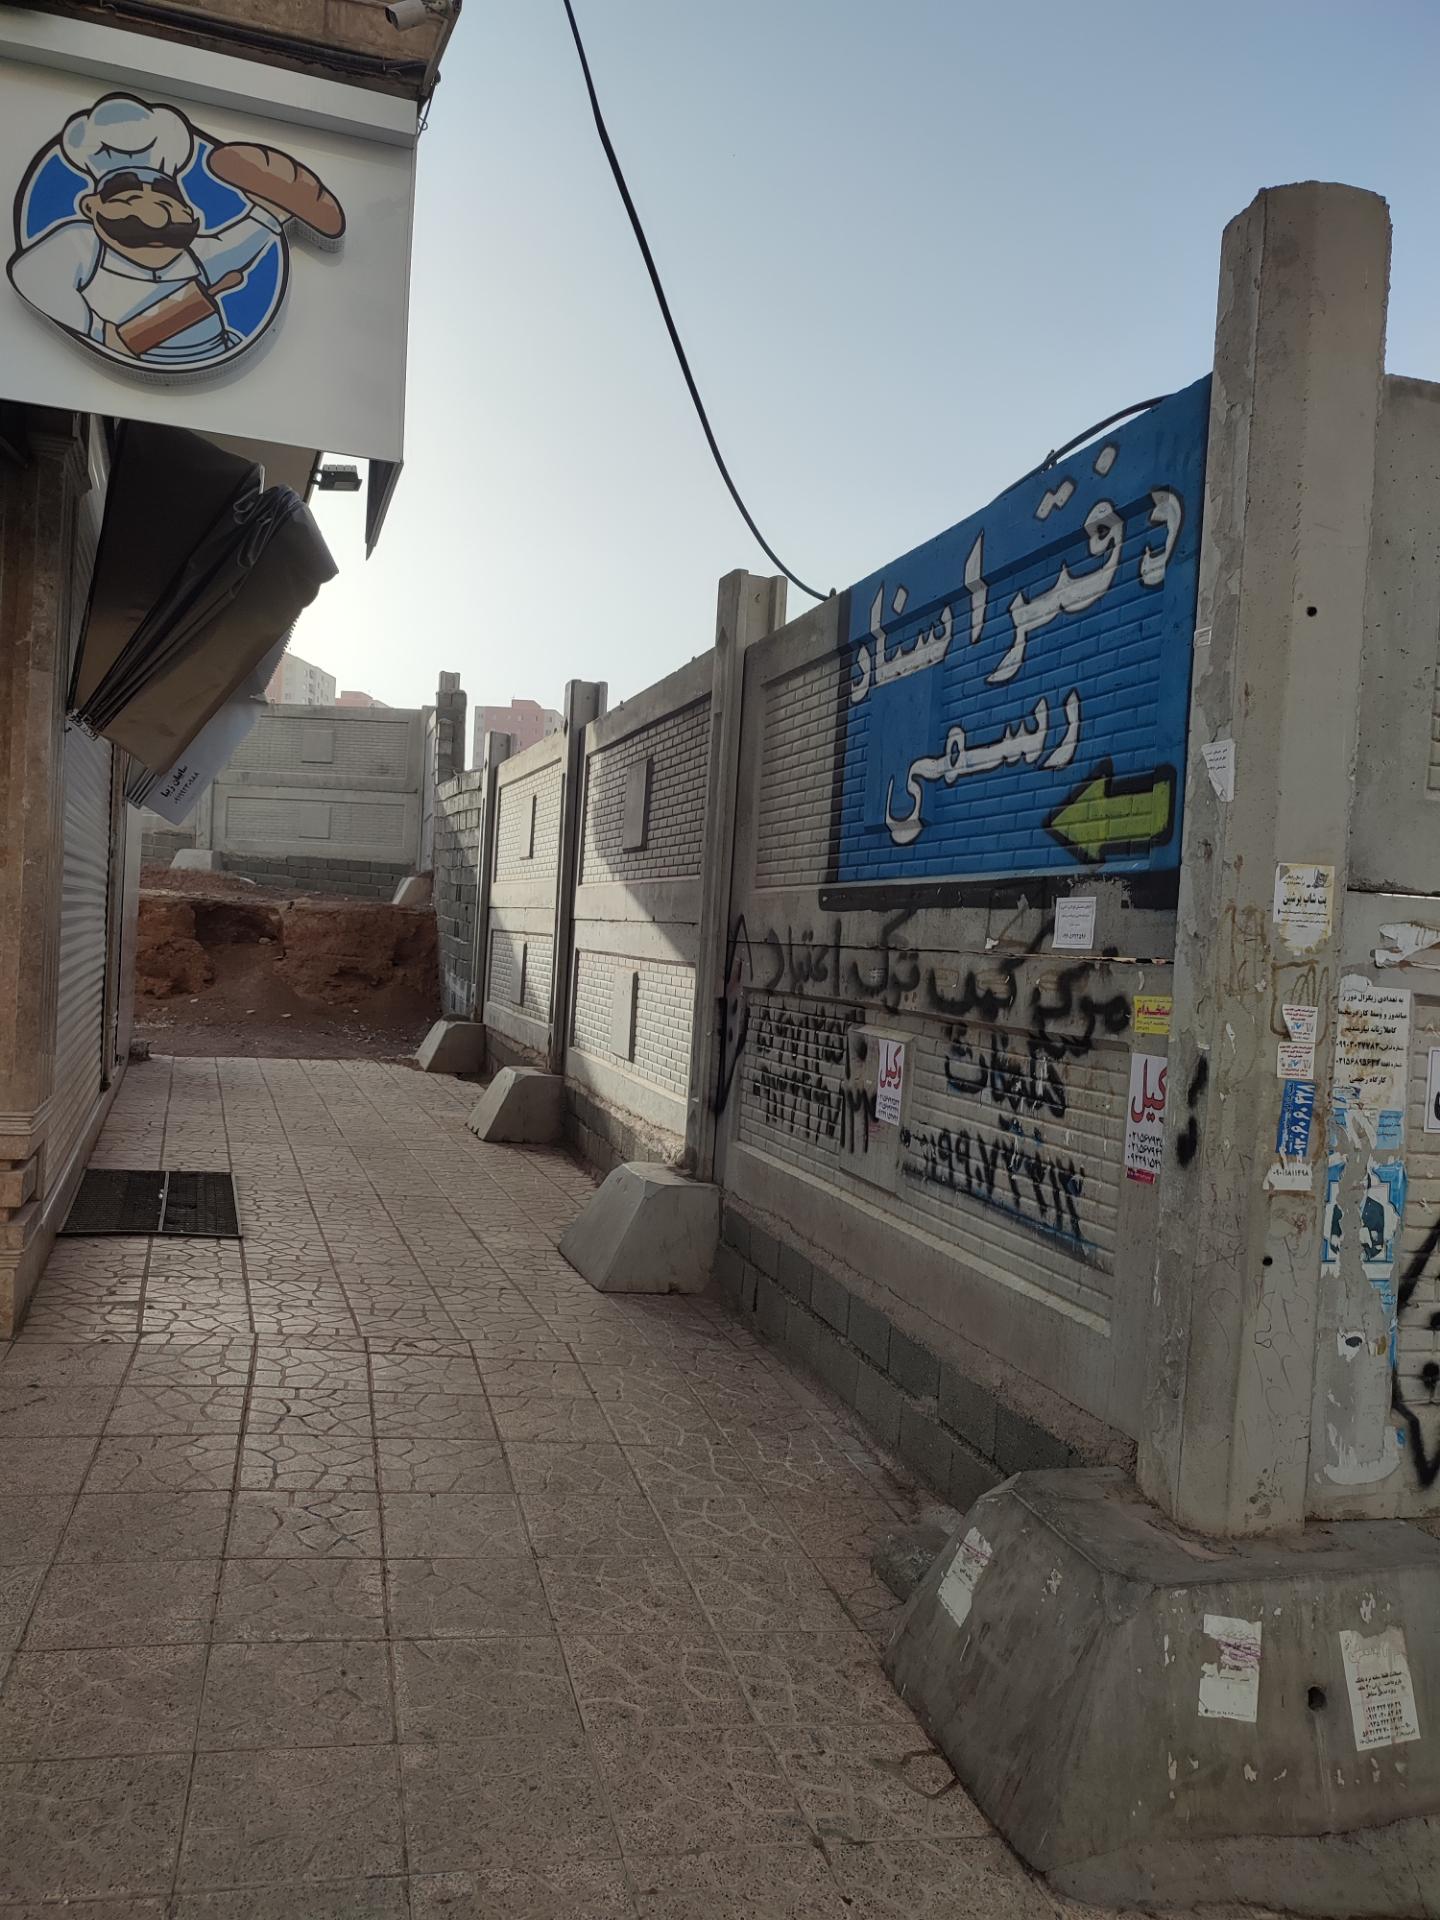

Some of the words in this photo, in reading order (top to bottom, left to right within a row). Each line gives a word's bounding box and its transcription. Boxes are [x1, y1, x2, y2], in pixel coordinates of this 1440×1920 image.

[848, 527, 990, 707] اسناد
[986, 444, 1184, 684] دفتر
[884, 687, 1083, 846] رسمی
[880, 1043, 902, 1090] وکیل
[1131, 1058, 1167, 1124] کیل
